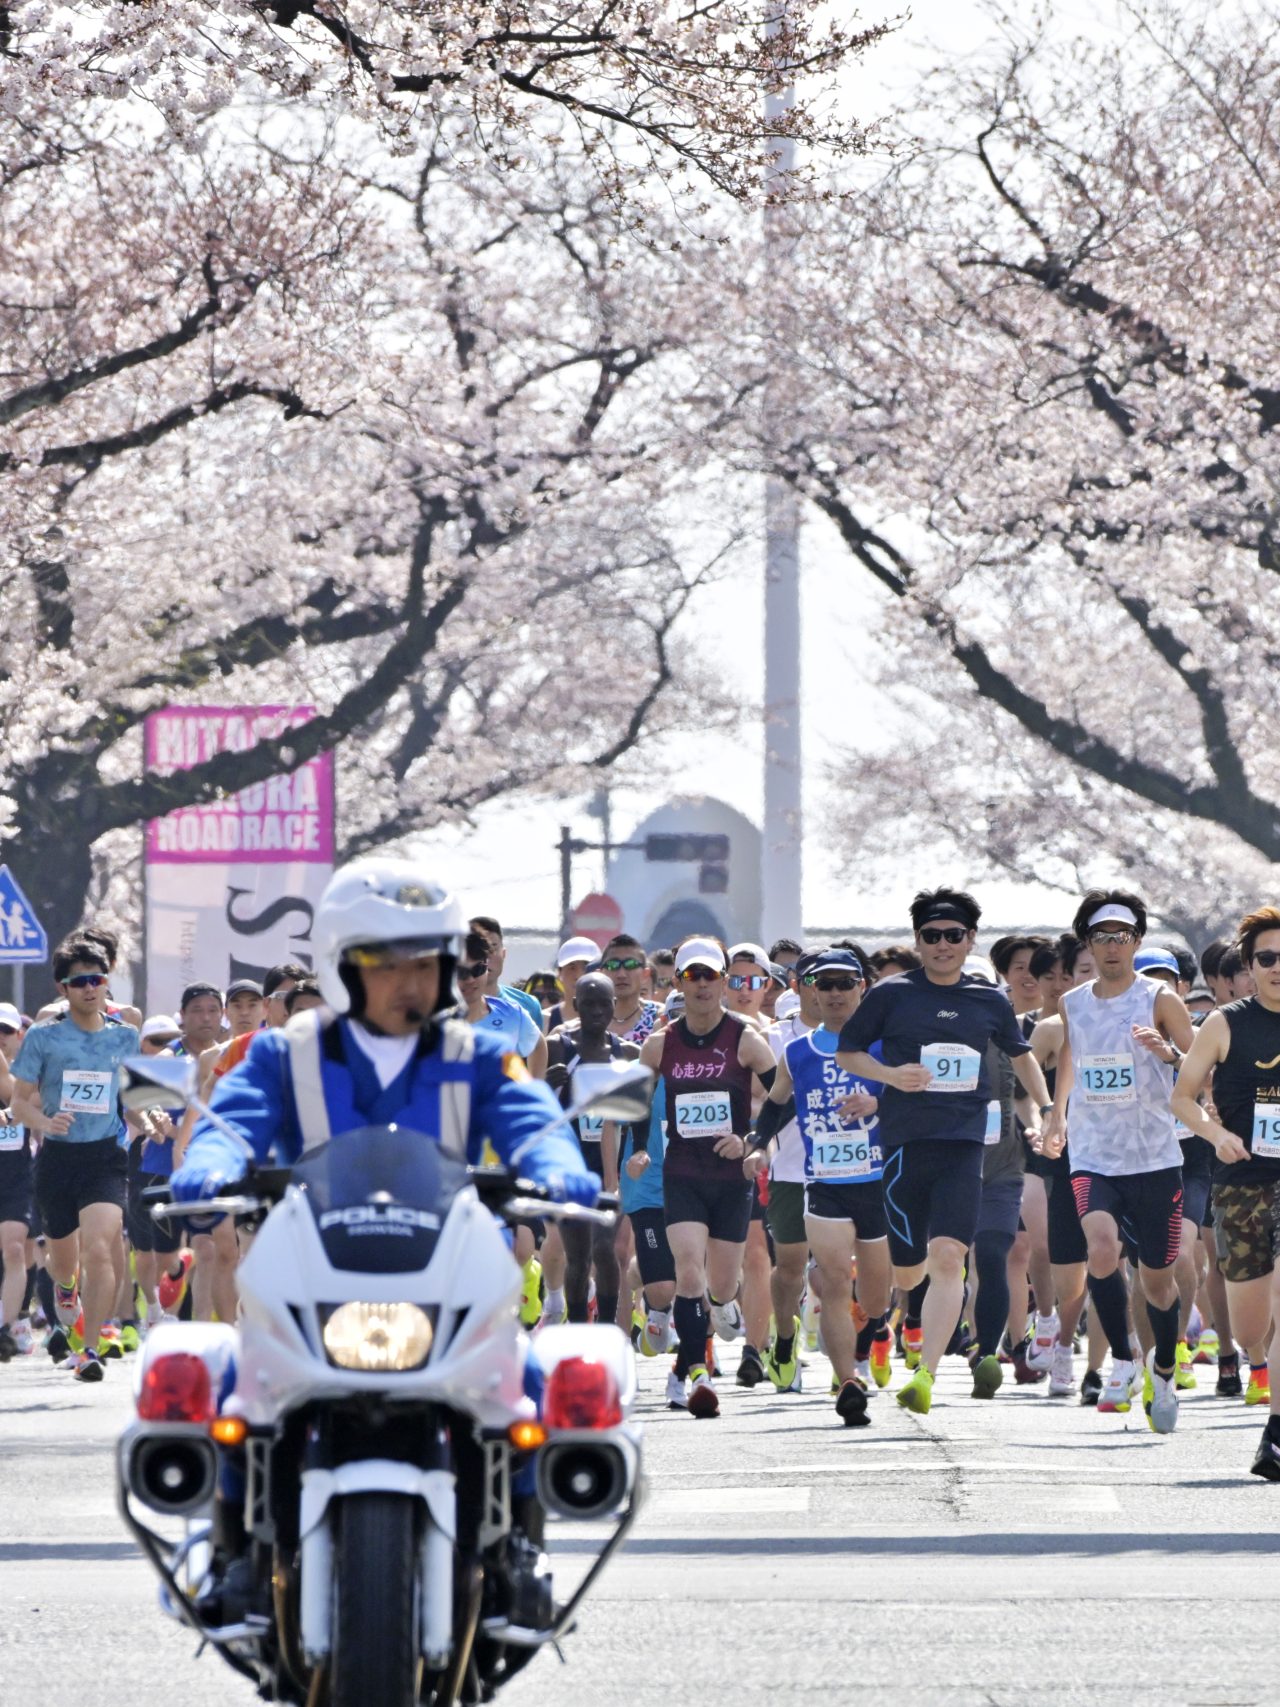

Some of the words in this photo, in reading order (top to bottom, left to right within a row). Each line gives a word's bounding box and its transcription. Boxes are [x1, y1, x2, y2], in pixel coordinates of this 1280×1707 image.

[157, 813, 320, 851] ROADRACE
[672, 1062, 726, 1079] 心走クラブ
[936, 1058, 962, 1078] 91
[1084, 1068, 1132, 1089] 1325
[70, 1084, 105, 1100] 757
[678, 1104, 729, 1125] 2203
[816, 1143, 868, 1164] 1256
[319, 1205, 440, 1230] POLICE
